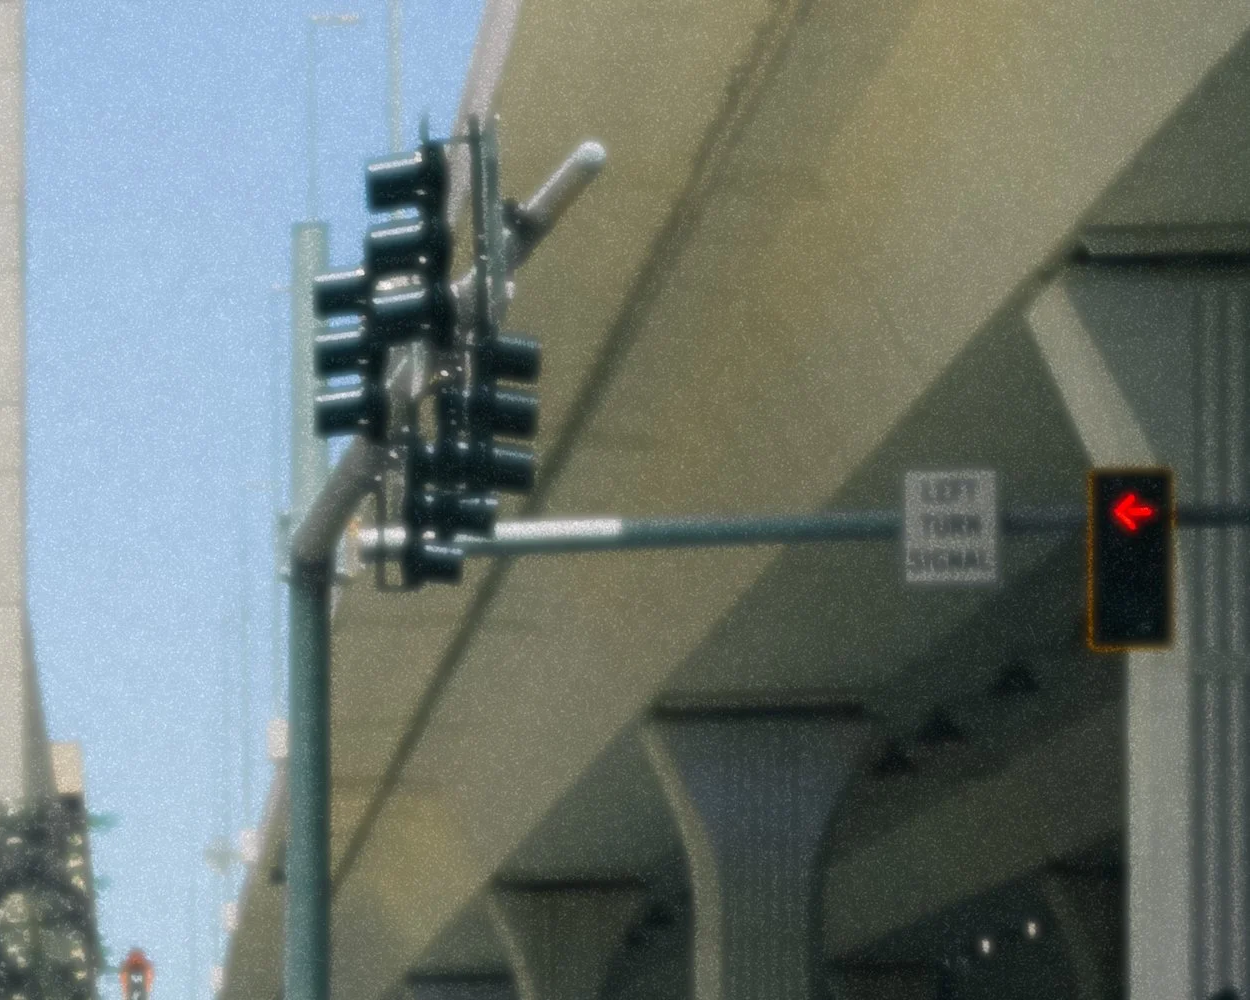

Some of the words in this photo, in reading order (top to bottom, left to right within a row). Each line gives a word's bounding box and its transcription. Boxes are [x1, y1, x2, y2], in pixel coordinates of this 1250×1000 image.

[921, 481, 976, 502] LEFT
[920, 514, 981, 537] TURN
[909, 548, 991, 573] SIGNAL
